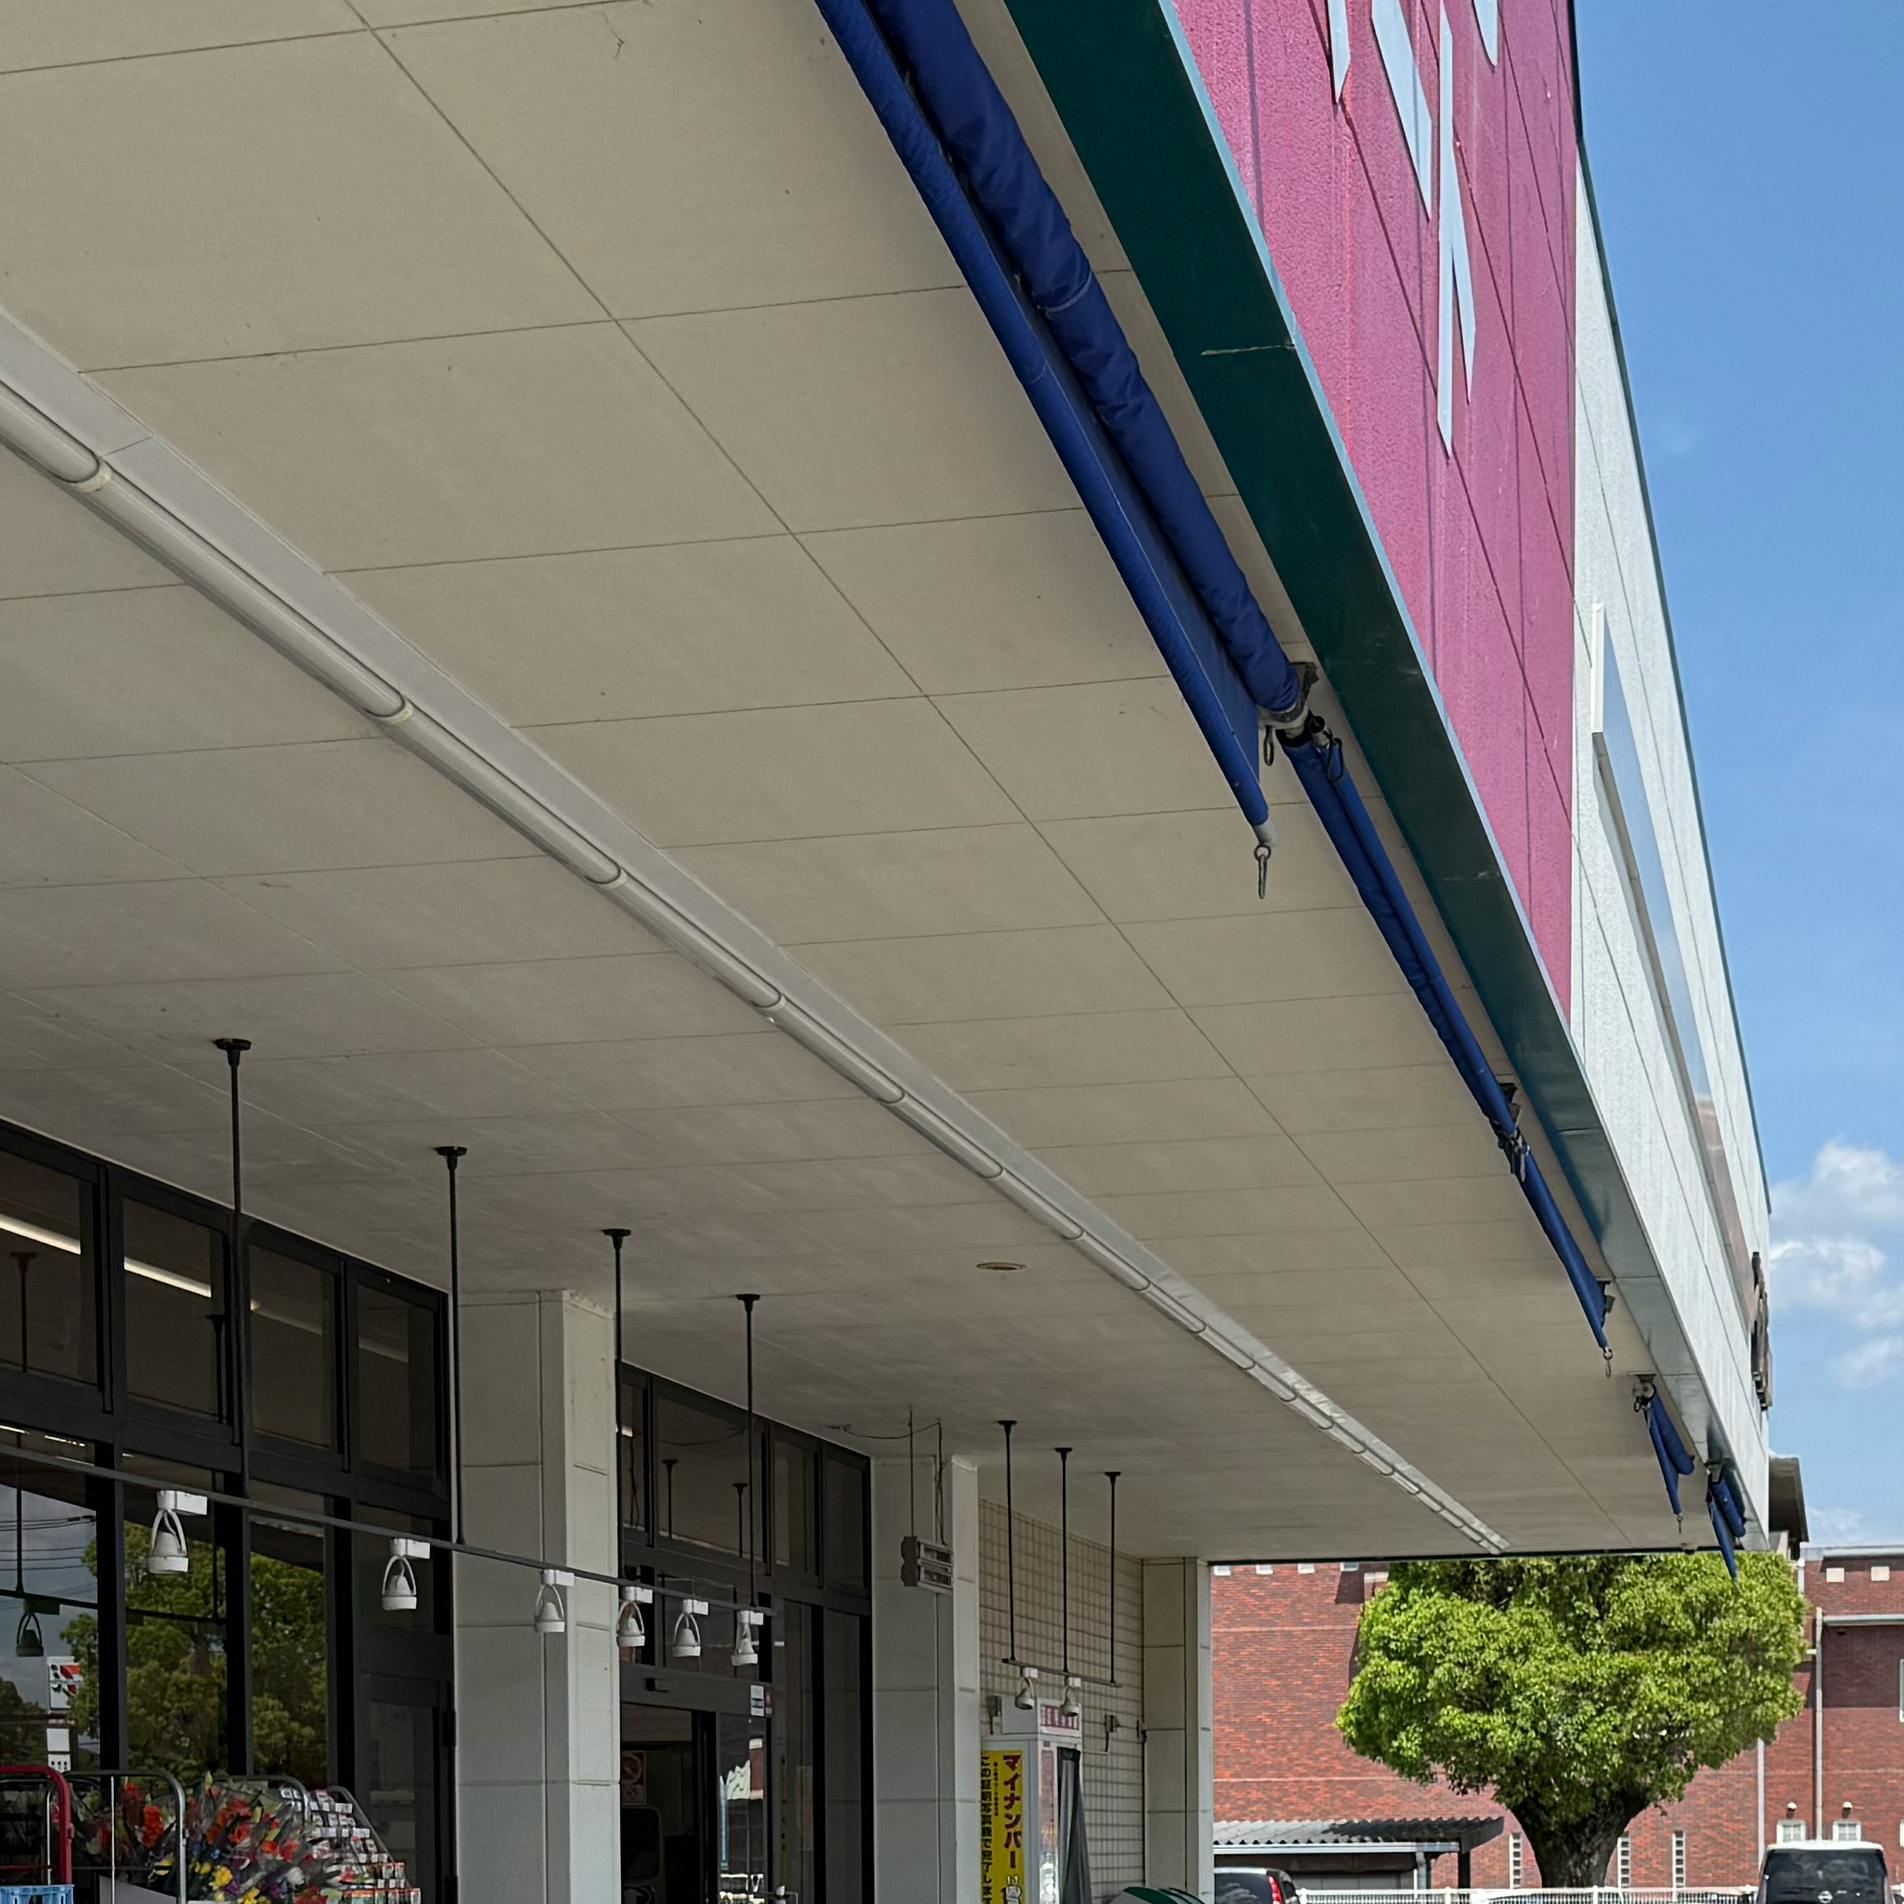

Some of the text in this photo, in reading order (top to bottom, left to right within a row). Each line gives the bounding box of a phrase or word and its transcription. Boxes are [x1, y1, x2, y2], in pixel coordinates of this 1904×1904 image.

[1003, 1754, 1022, 1869] マイナンバー
